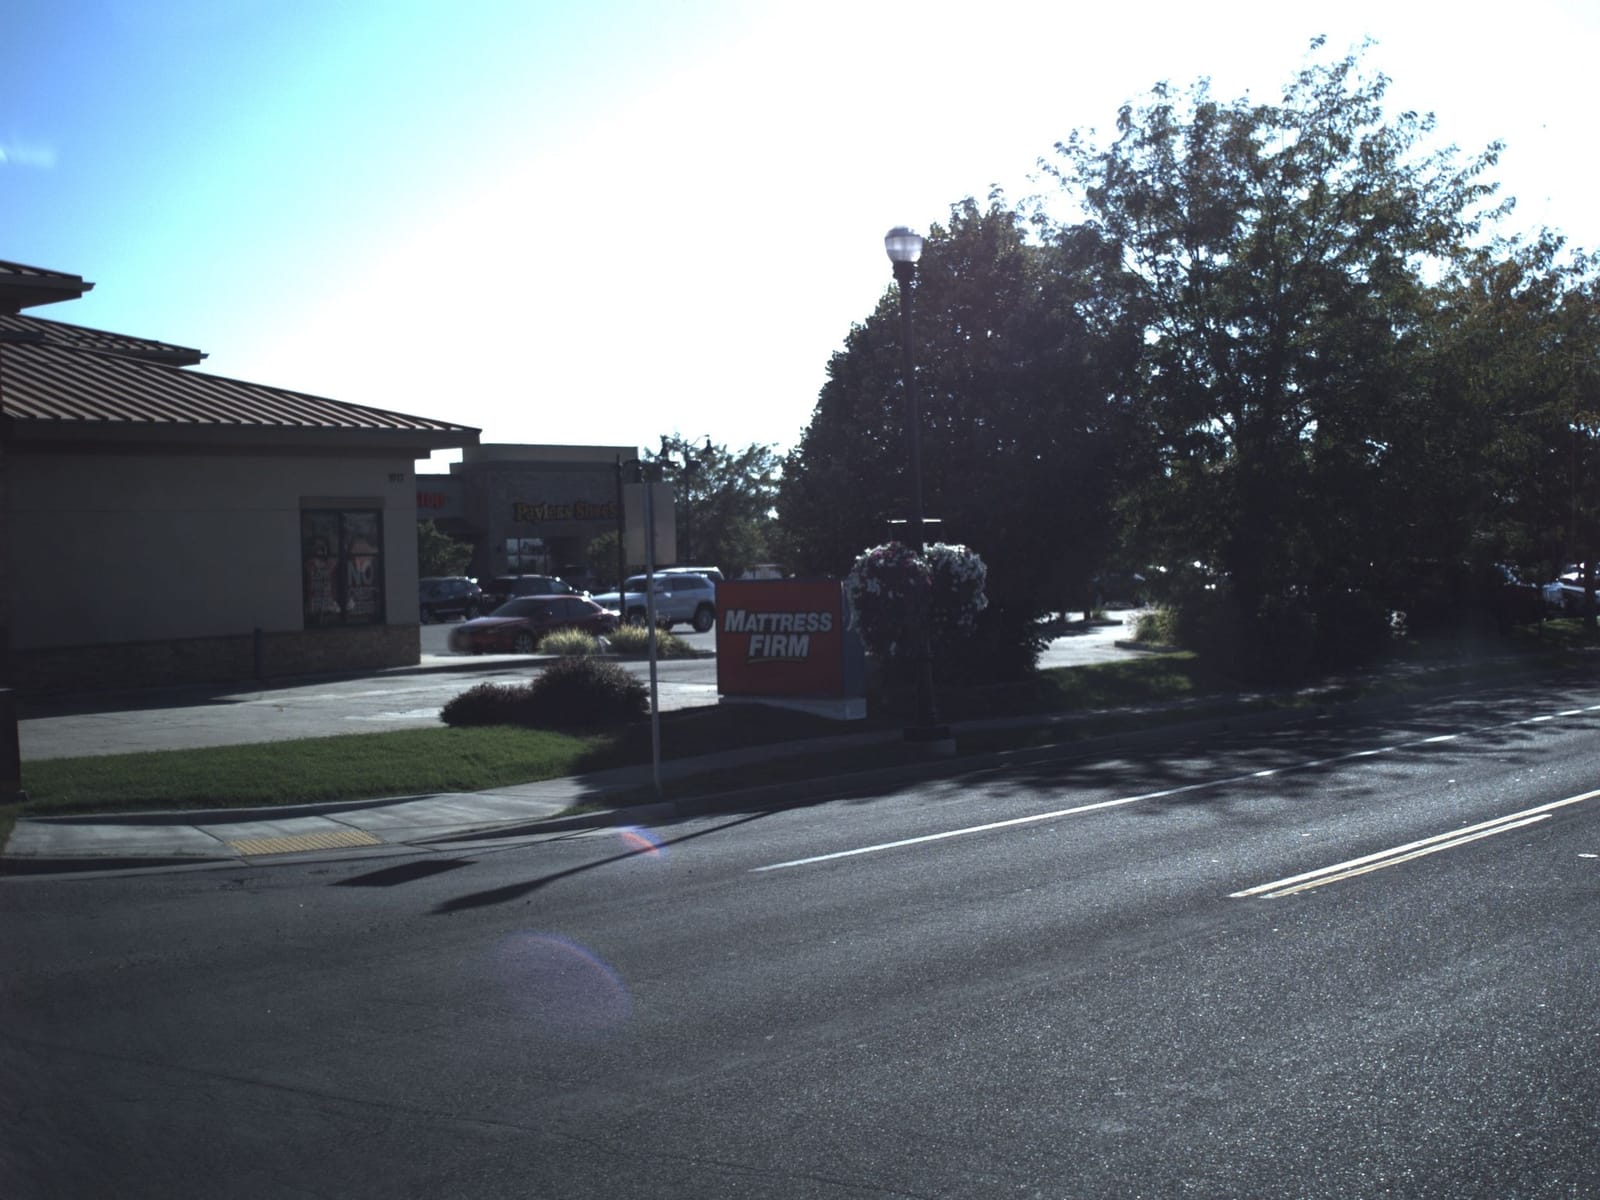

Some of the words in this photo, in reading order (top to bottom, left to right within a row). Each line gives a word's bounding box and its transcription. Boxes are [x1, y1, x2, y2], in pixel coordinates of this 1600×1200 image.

[516, 502, 572, 523] Payless
[724, 609, 832, 633] MATTRESS
[748, 634, 810, 657] FIRM
